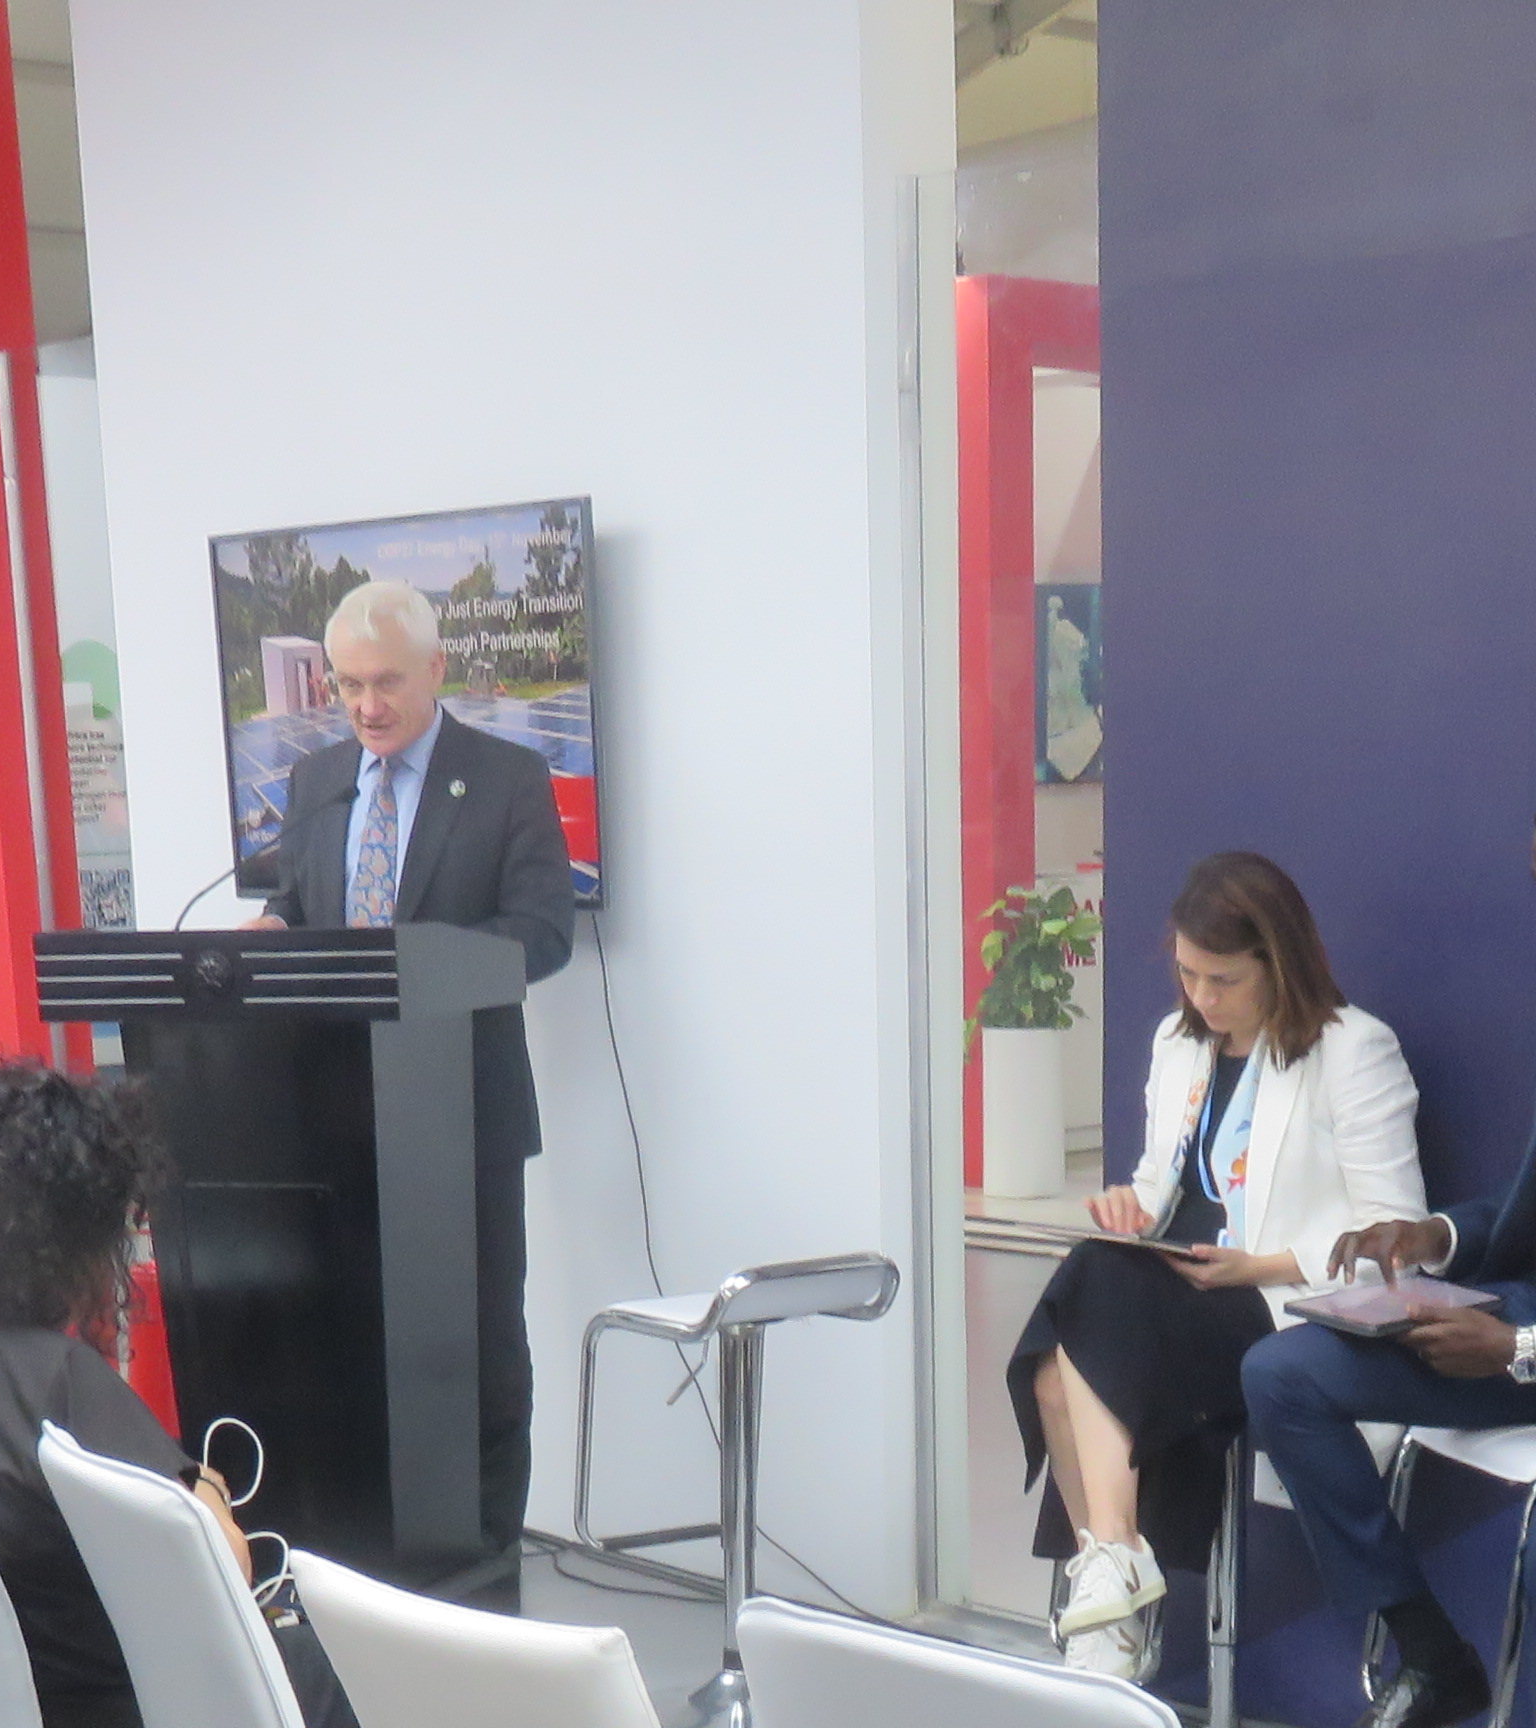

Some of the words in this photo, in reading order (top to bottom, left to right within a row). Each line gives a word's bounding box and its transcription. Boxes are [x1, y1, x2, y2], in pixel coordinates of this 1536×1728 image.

[445, 600, 471, 620] Just
[473, 597, 518, 621] Energy
[520, 591, 583, 615] Transition
[480, 628, 561, 653] Partnerships
